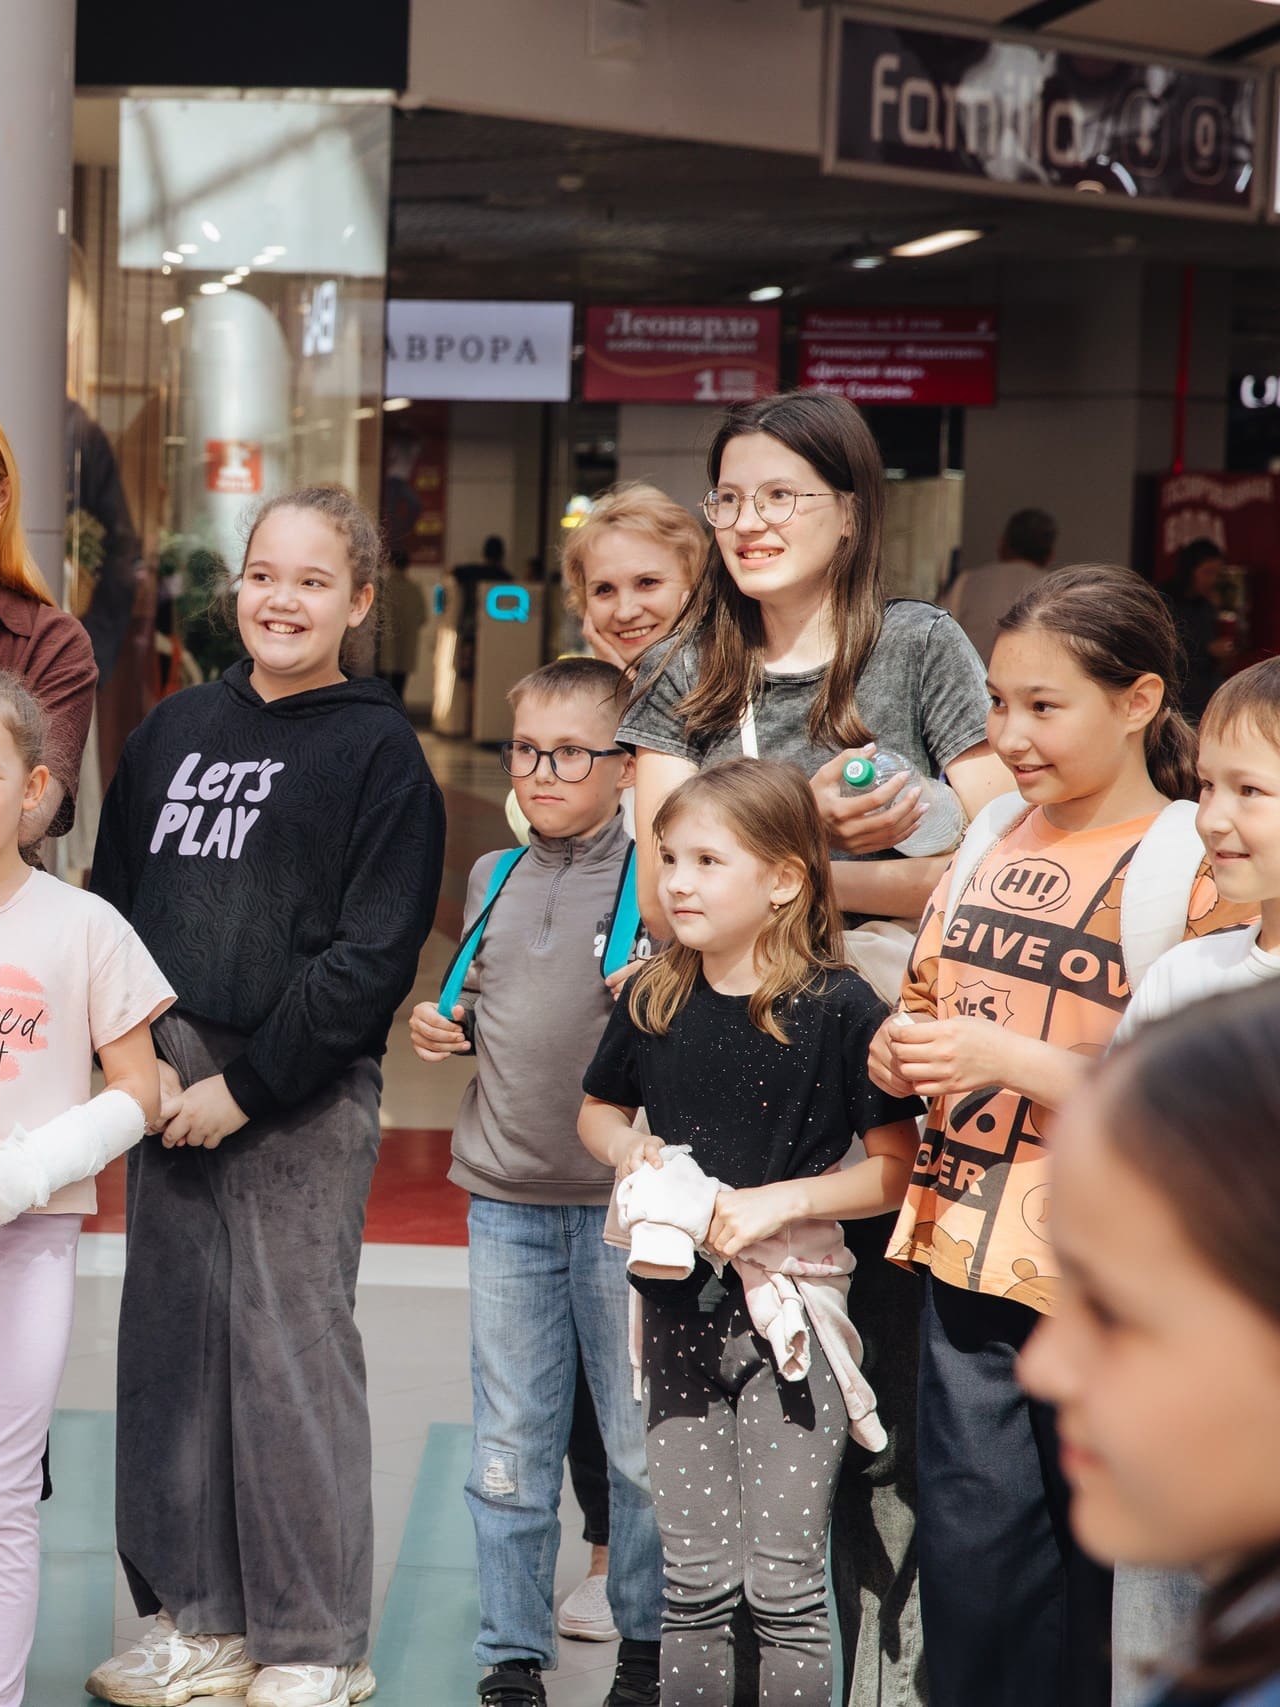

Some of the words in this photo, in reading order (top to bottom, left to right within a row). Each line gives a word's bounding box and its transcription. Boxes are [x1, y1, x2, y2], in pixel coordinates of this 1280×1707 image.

[149, 802, 261, 860] PLAY
[999, 867, 1061, 903] HI!
[944, 917, 1052, 972] GIVE
